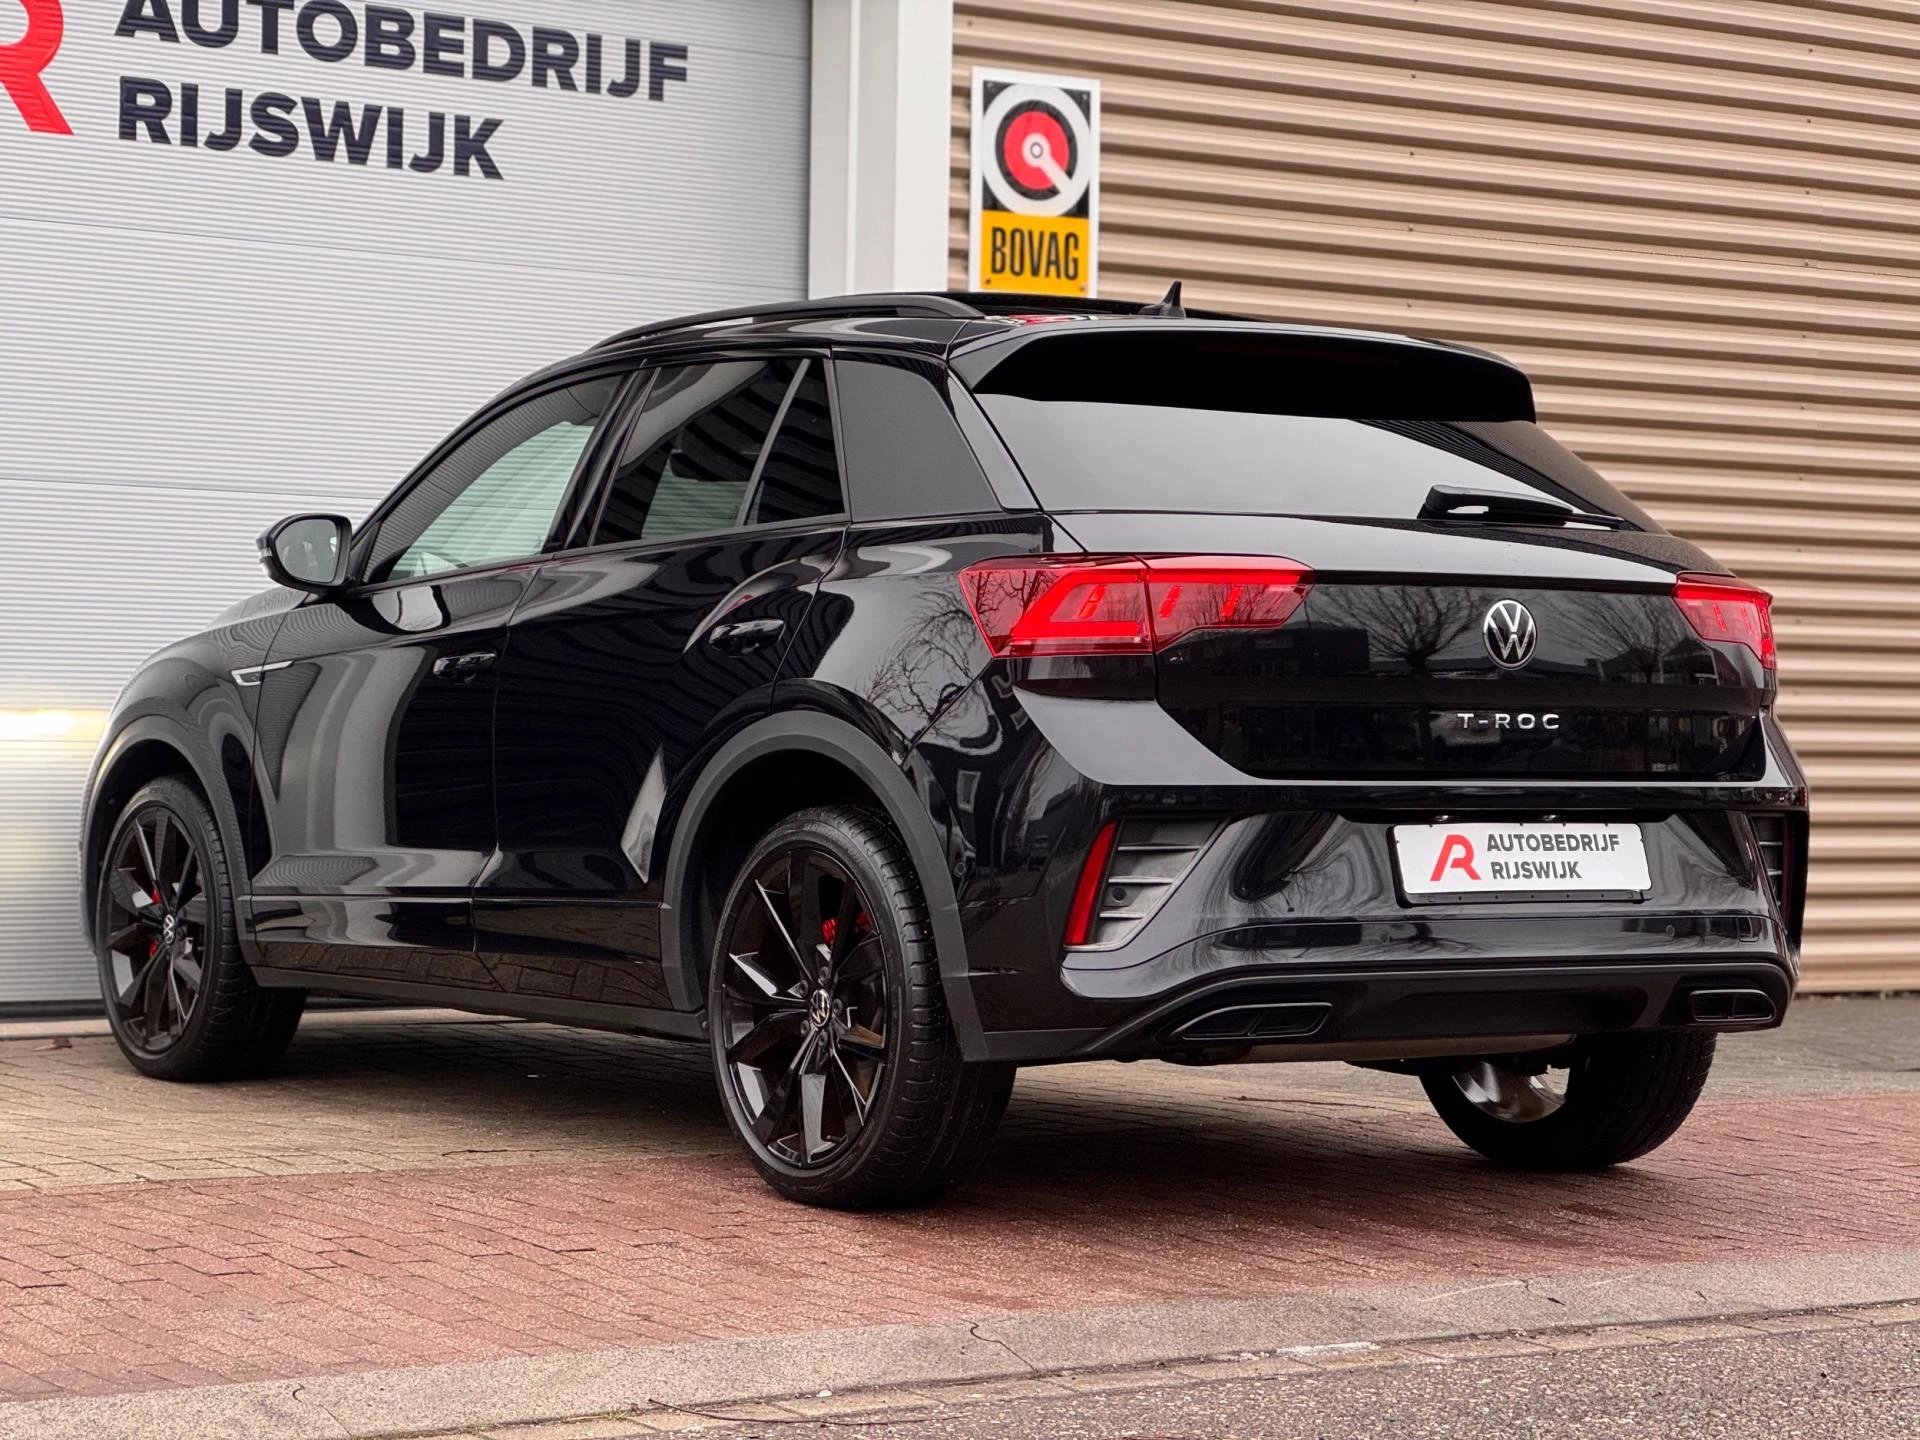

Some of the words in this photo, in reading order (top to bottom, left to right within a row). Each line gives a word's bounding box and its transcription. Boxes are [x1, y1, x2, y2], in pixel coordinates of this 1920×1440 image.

[115, 0, 688, 101] AUTOBEDRIJF
[118, 75, 504, 180] RIJSWIJK
[991, 226, 1079, 281] BOVAG
[1457, 713, 1560, 729] T-ROC
[1487, 834, 1620, 851] AUTOBEDRIJF
[1490, 861, 1583, 879] RIJSWIJK
